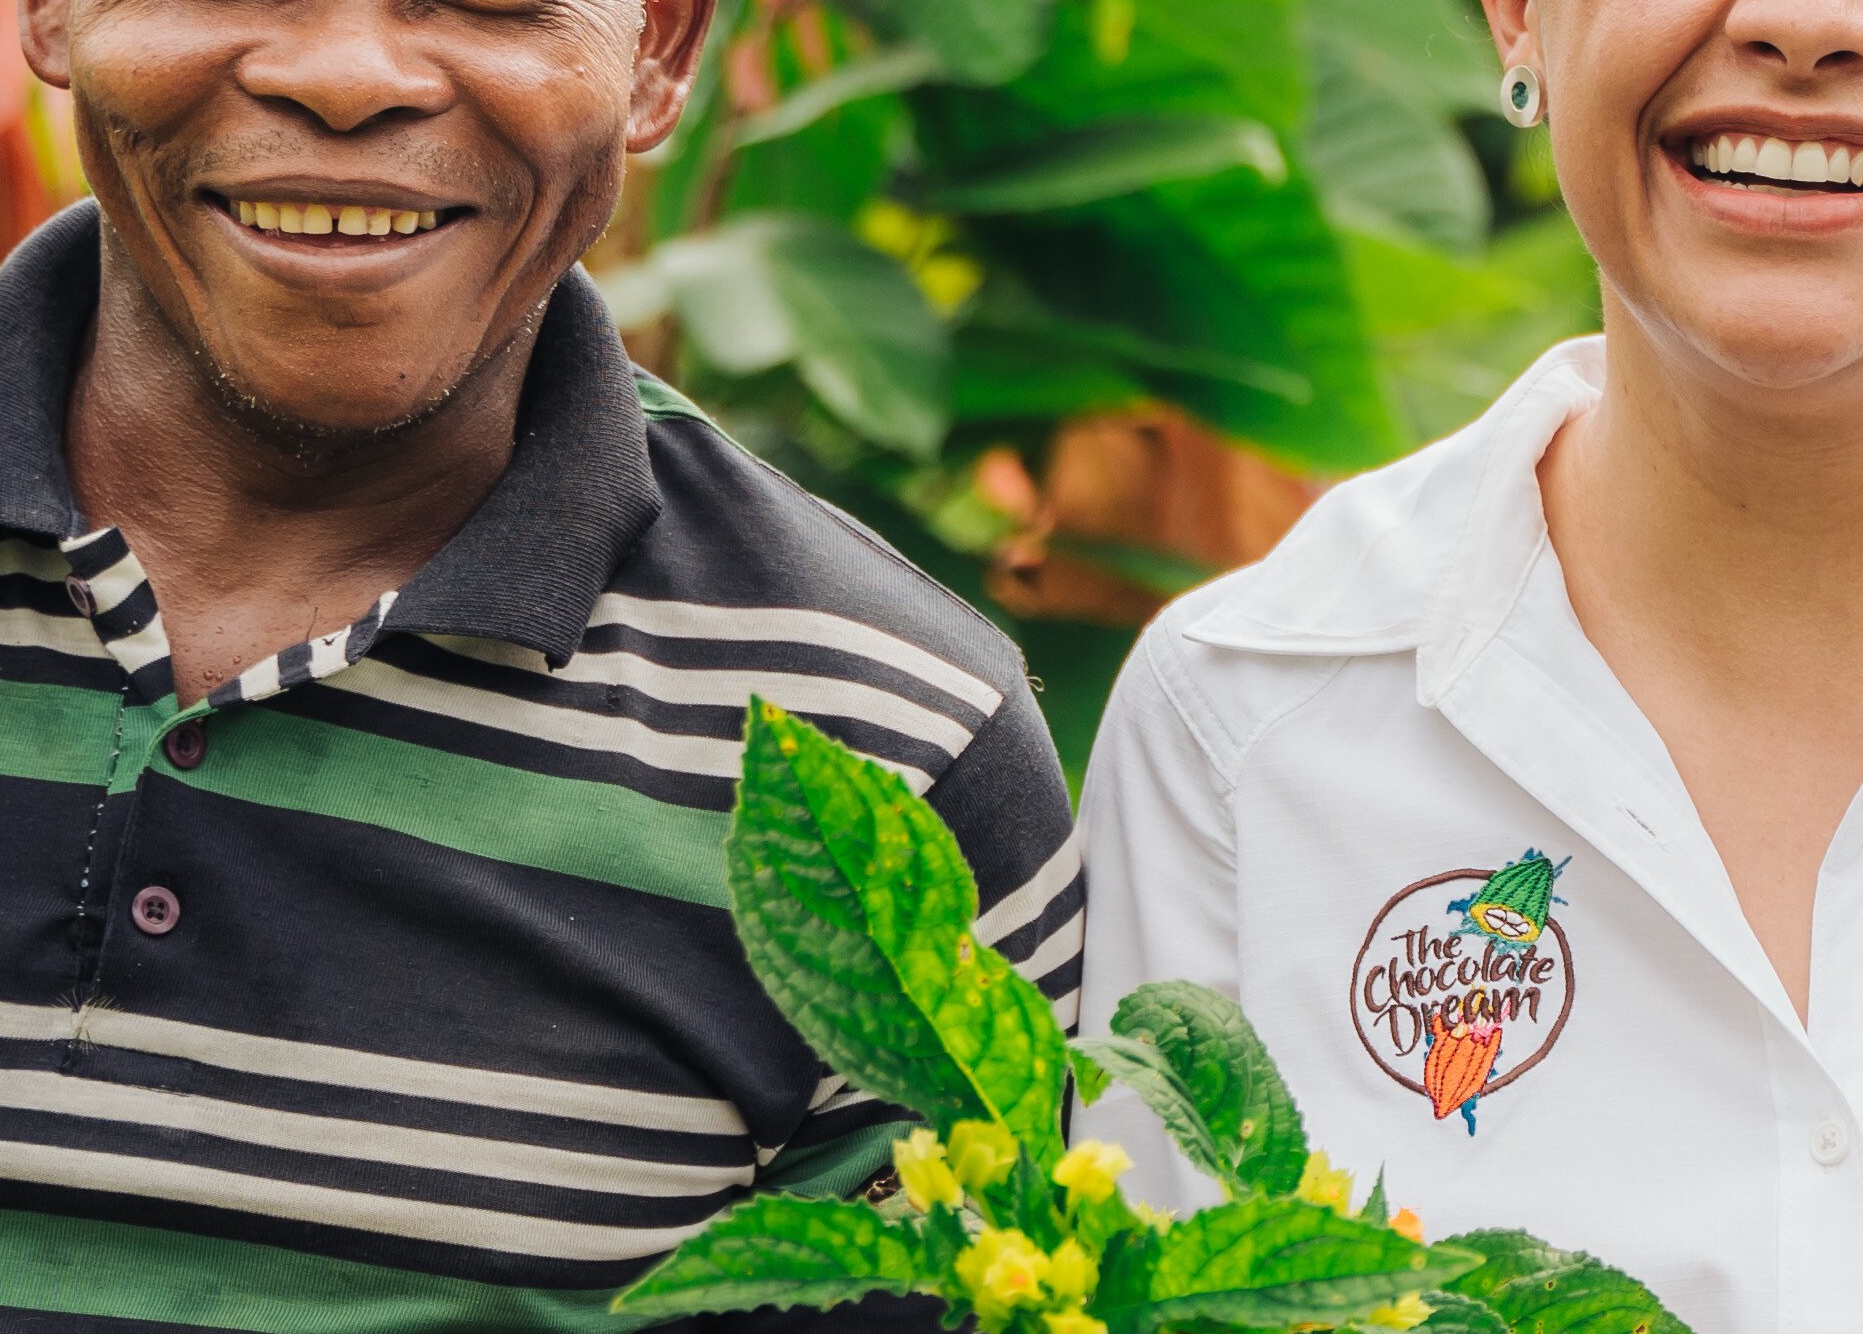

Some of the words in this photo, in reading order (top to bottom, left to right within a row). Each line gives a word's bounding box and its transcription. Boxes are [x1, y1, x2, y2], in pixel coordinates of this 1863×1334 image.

[1364, 938, 1554, 1013] Chocolate
[1391, 925, 1462, 966] The
[1373, 987, 1541, 1056] Dream
